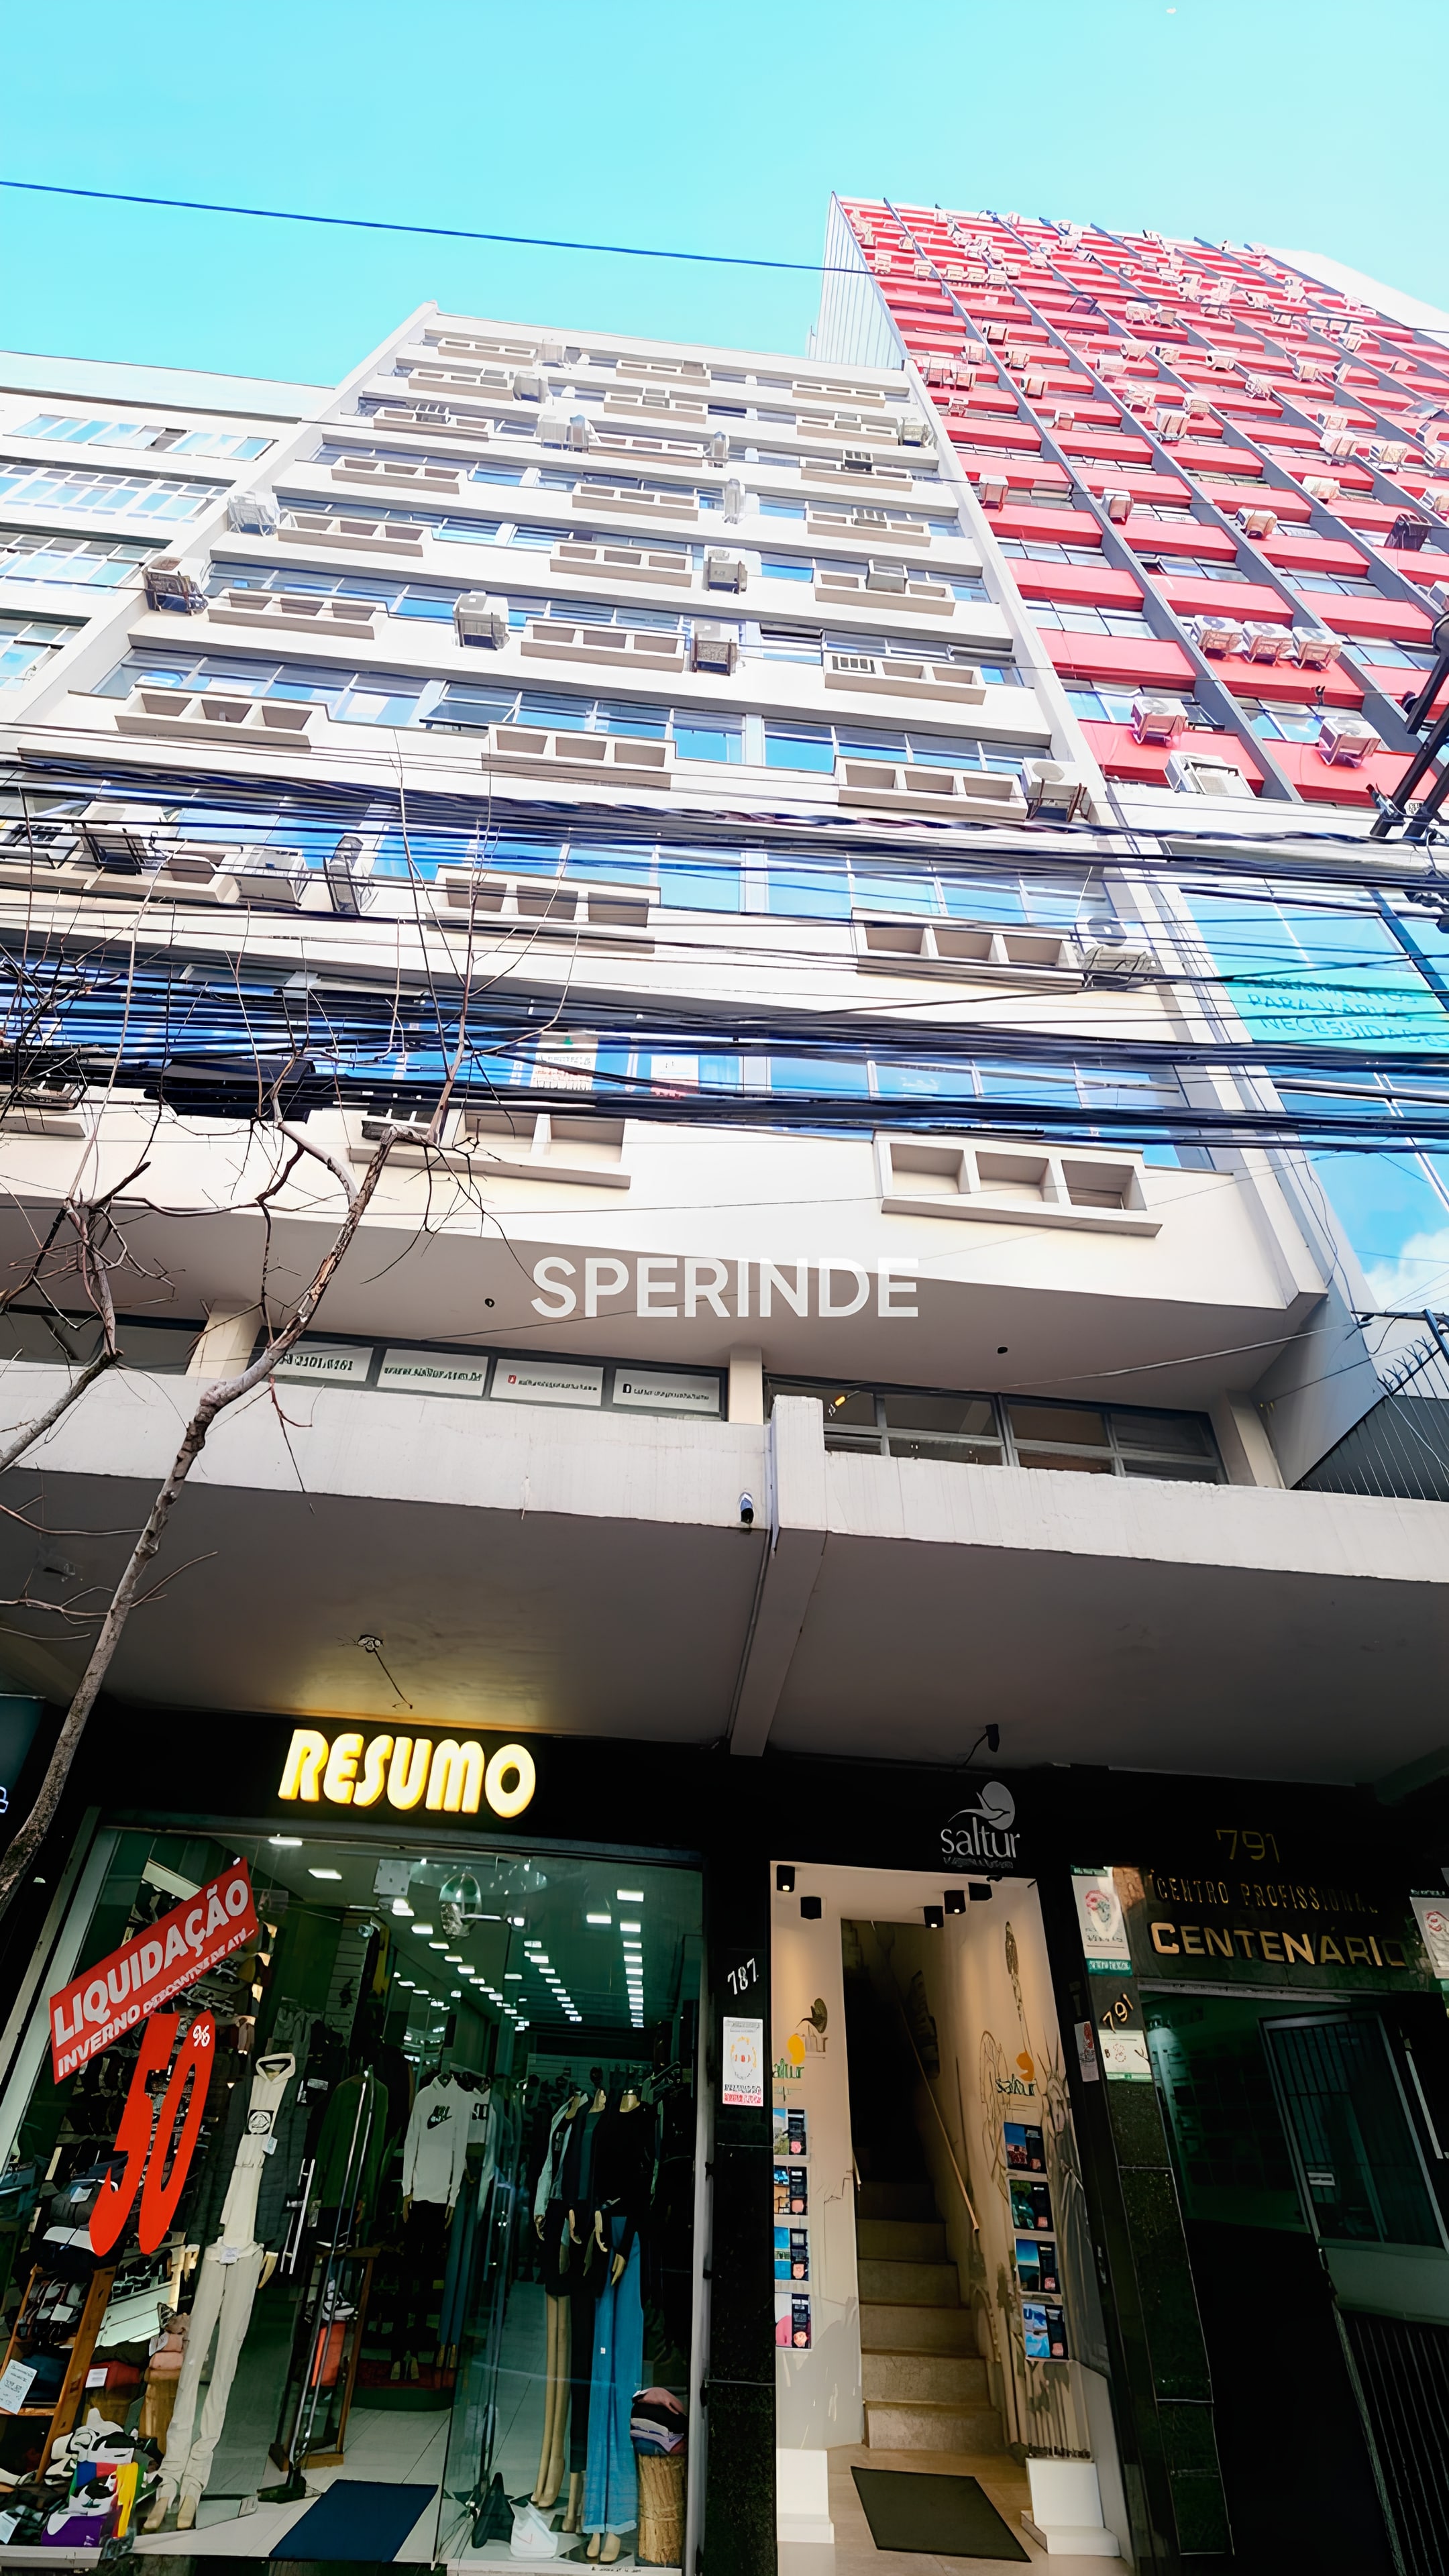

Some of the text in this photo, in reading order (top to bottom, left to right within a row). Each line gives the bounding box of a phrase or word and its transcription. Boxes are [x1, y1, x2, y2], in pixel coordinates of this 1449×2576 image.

[278, 1729, 536, 1819] RESUMO
[941, 1817, 1020, 1858] saltur
[1216, 1829, 1281, 1863] 791
[1156, 1878, 1379, 1914] CENTRO PROFISSIONA
[54, 1879, 248, 2048] LIQUIDAÇÃO
[1150, 1922, 1409, 1967] CENTENÁRIO
[727, 1957, 757, 1995] 787
[1102, 1992, 1134, 2034] 791
[58, 2004, 140, 2078] INVERNO
[772, 2057, 805, 2079] altur
